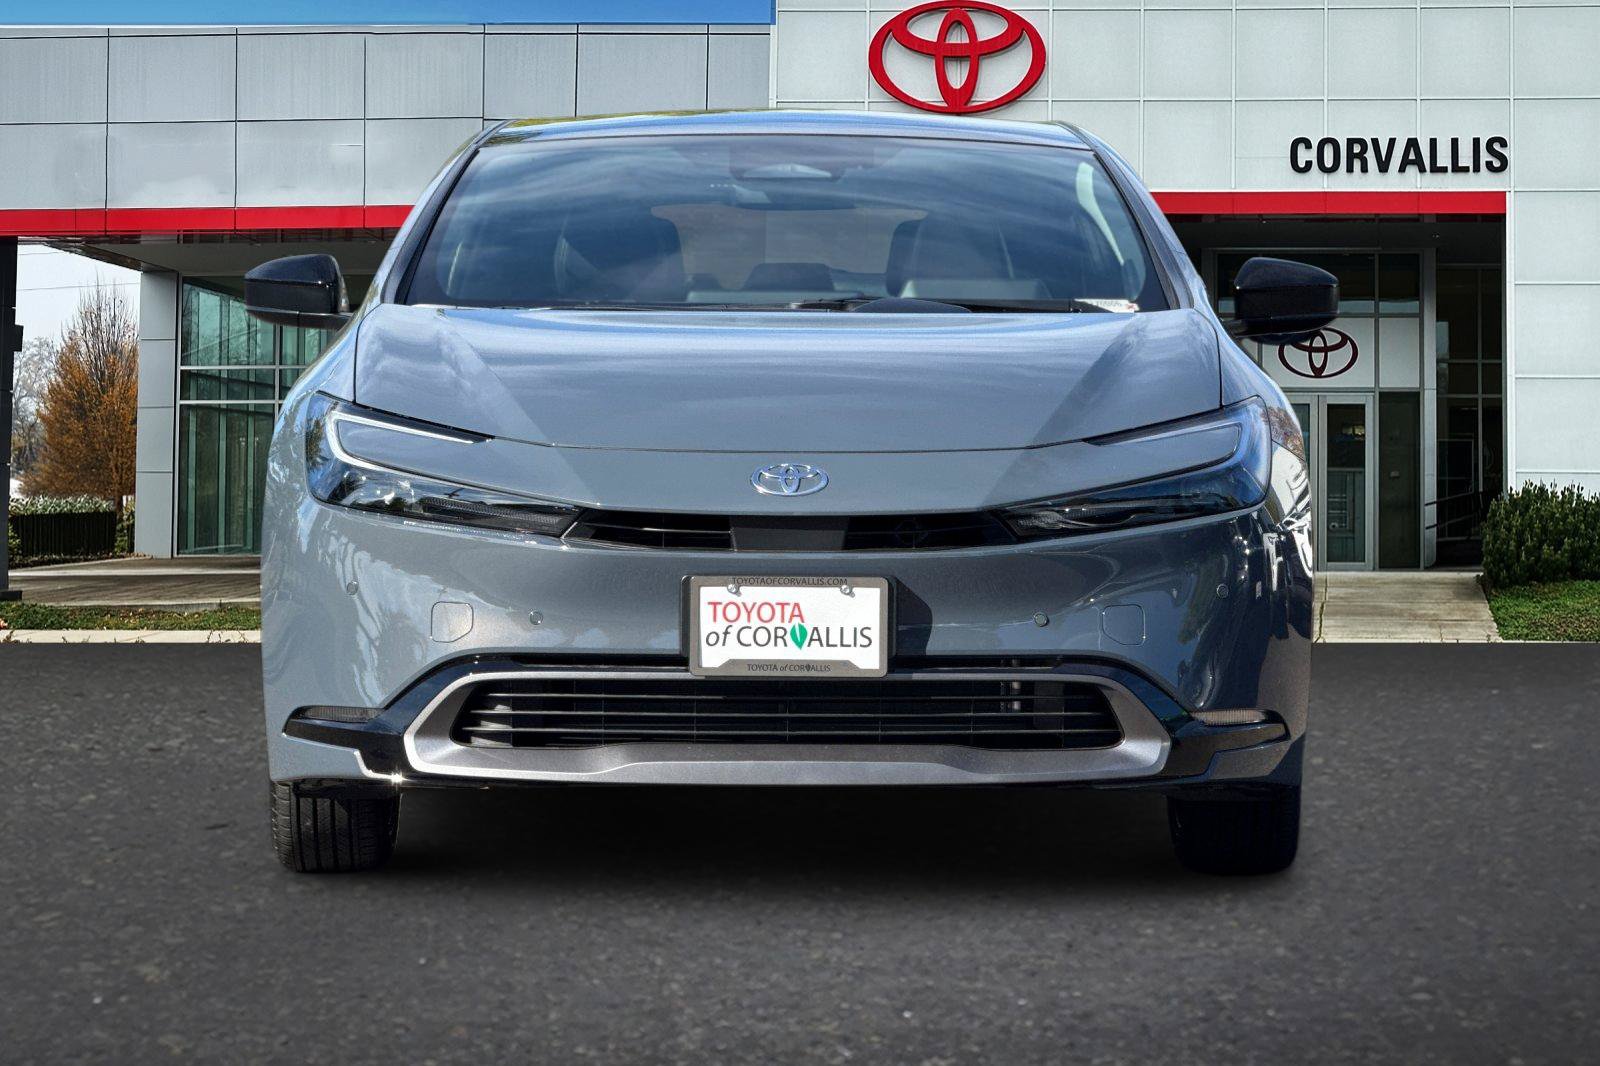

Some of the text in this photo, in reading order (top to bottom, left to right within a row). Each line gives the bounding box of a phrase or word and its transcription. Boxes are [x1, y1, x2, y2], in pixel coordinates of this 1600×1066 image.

[1289, 136, 1509, 174] CORVALLIS
[732, 576, 848, 586] TOYOTAOFCORVALLIS.COM
[707, 601, 805, 624] TOYOTA
[705, 624, 733, 647] of
[746, 663, 778, 672] TOYOTA
[780, 663, 788, 672] of
